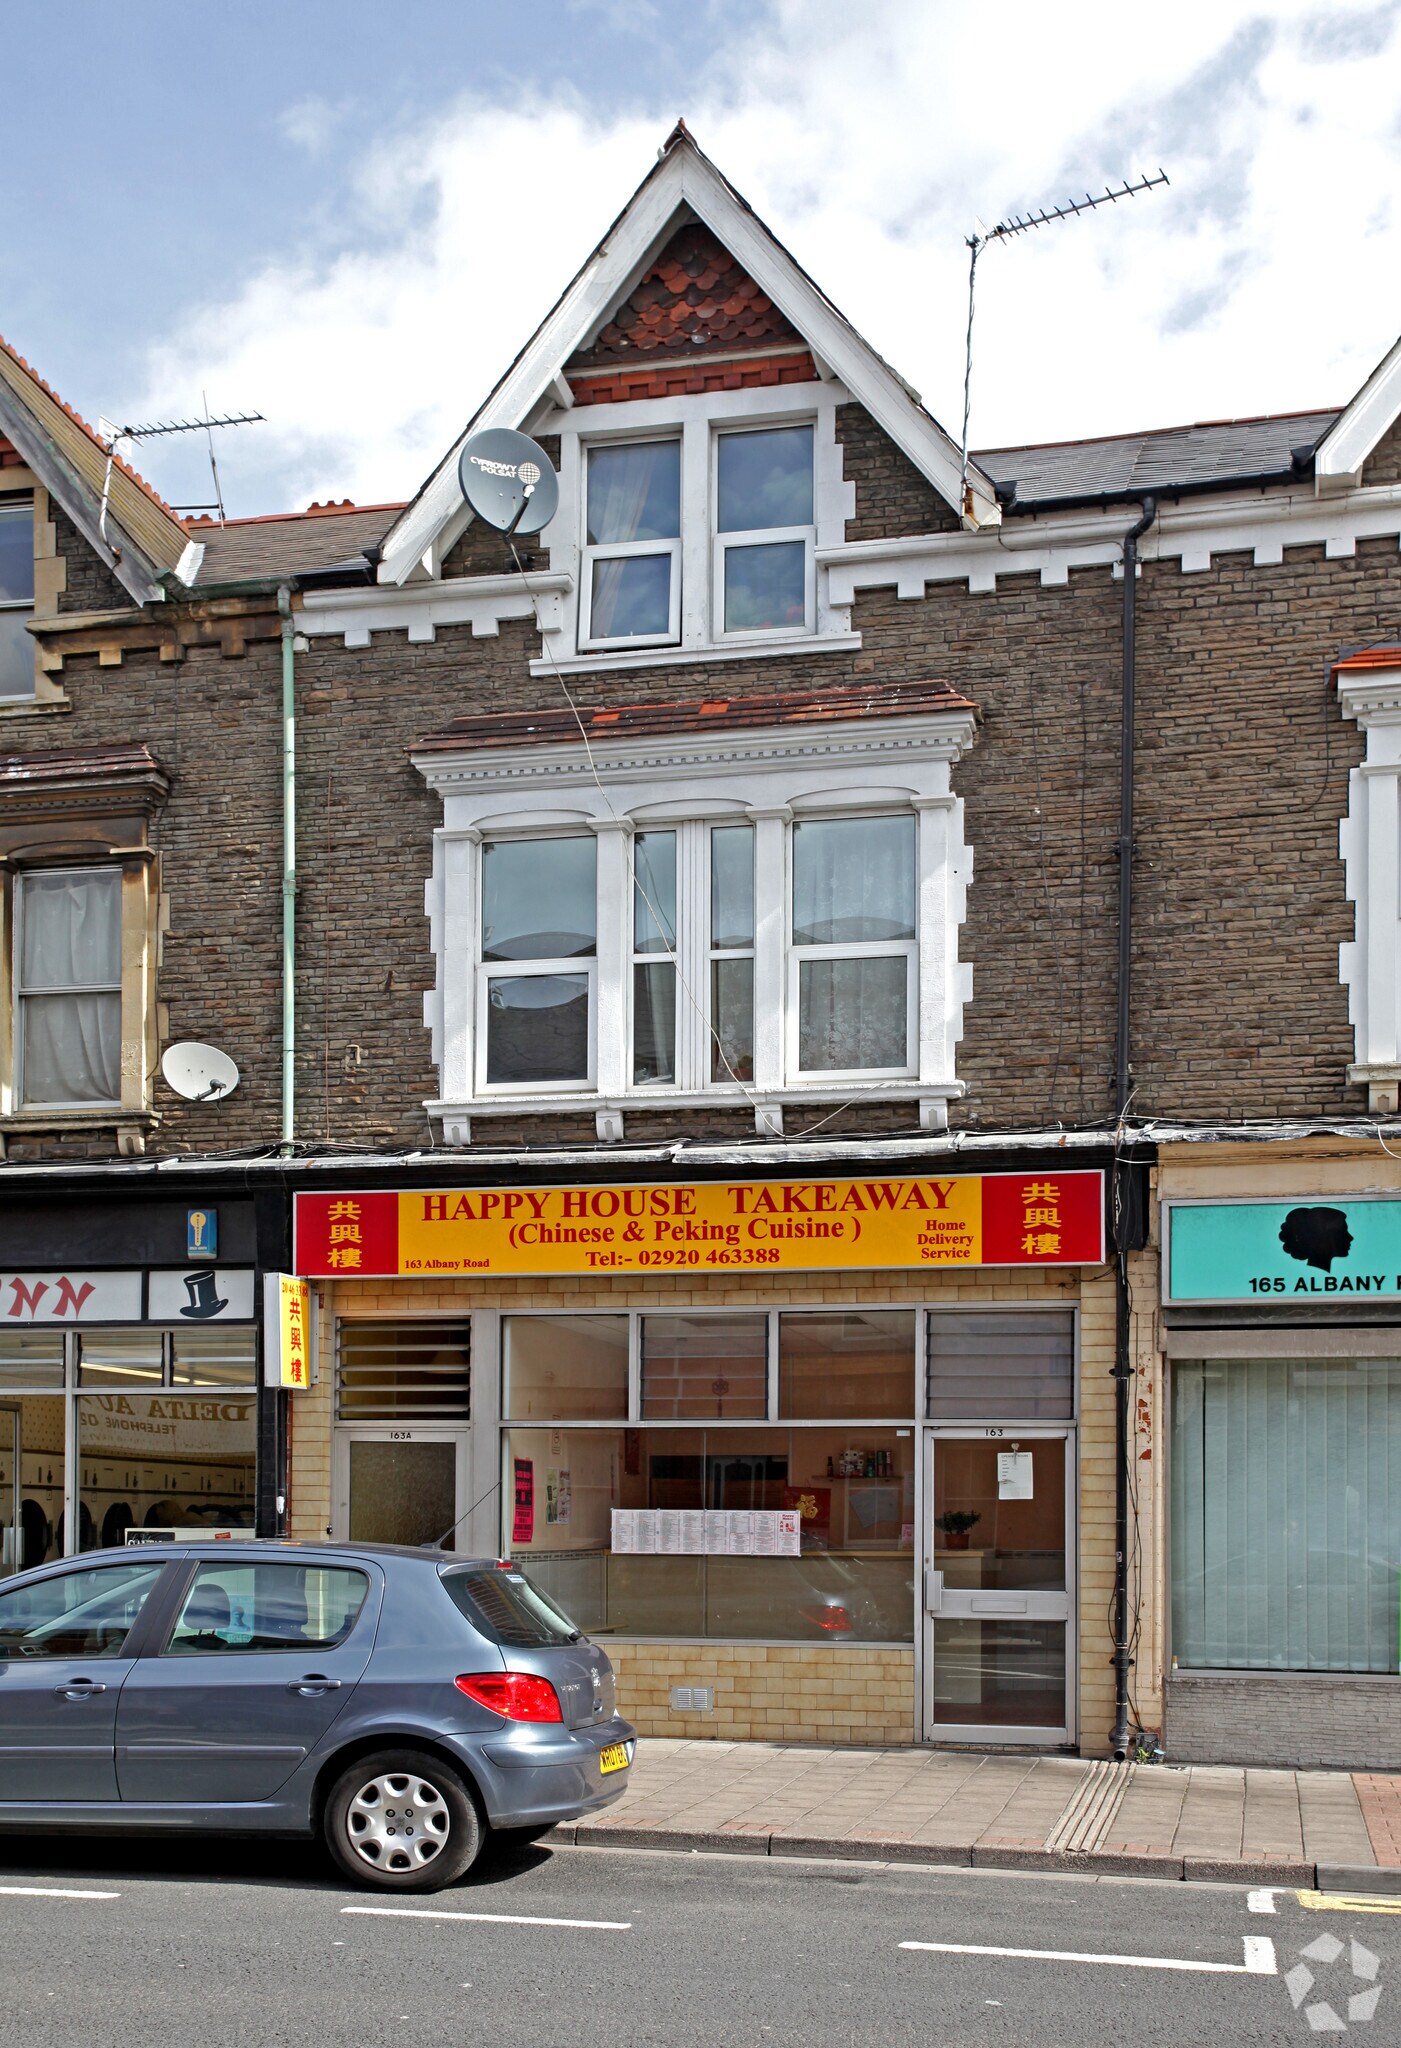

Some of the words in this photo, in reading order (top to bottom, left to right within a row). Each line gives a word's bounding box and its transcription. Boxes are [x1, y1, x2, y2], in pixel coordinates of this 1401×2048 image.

[480, 465, 517, 478] POLSAT
[421, 1192, 551, 1221] HAPPY
[560, 1188, 697, 1218] HOUSE
[727, 1181, 957, 1214] TAKEAWAY
[926, 1219, 966, 1231] Home
[1021, 1183, 1062, 1255] 共興樓
[327, 1200, 363, 1268] 共興樓
[508, 1222, 615, 1249] (Chinese
[622, 1220, 645, 1242] &
[653, 1219, 740, 1246] Peking
[747, 1216, 845, 1240] Cuisine
[917, 1233, 974, 1247] Delivery
[586, 1251, 633, 1266] Tel:-
[638, 1250, 699, 1265] 02920
[705, 1248, 780, 1264] 463388
[921, 1247, 970, 1259] Service
[405, 1259, 422, 1269] 163
[424, 1259, 461, 1270] Albany
[462, 1258, 490, 1268] Road
[1248, 1277, 1286, 1293] 165
[1293, 1275, 1386, 1292] ALBANY
[0, 1276, 96, 1319] NN
[290, 1297, 302, 1383] 共興樓
[390, 1432, 411, 1440] 163A
[985, 1428, 1003, 1437] 163
